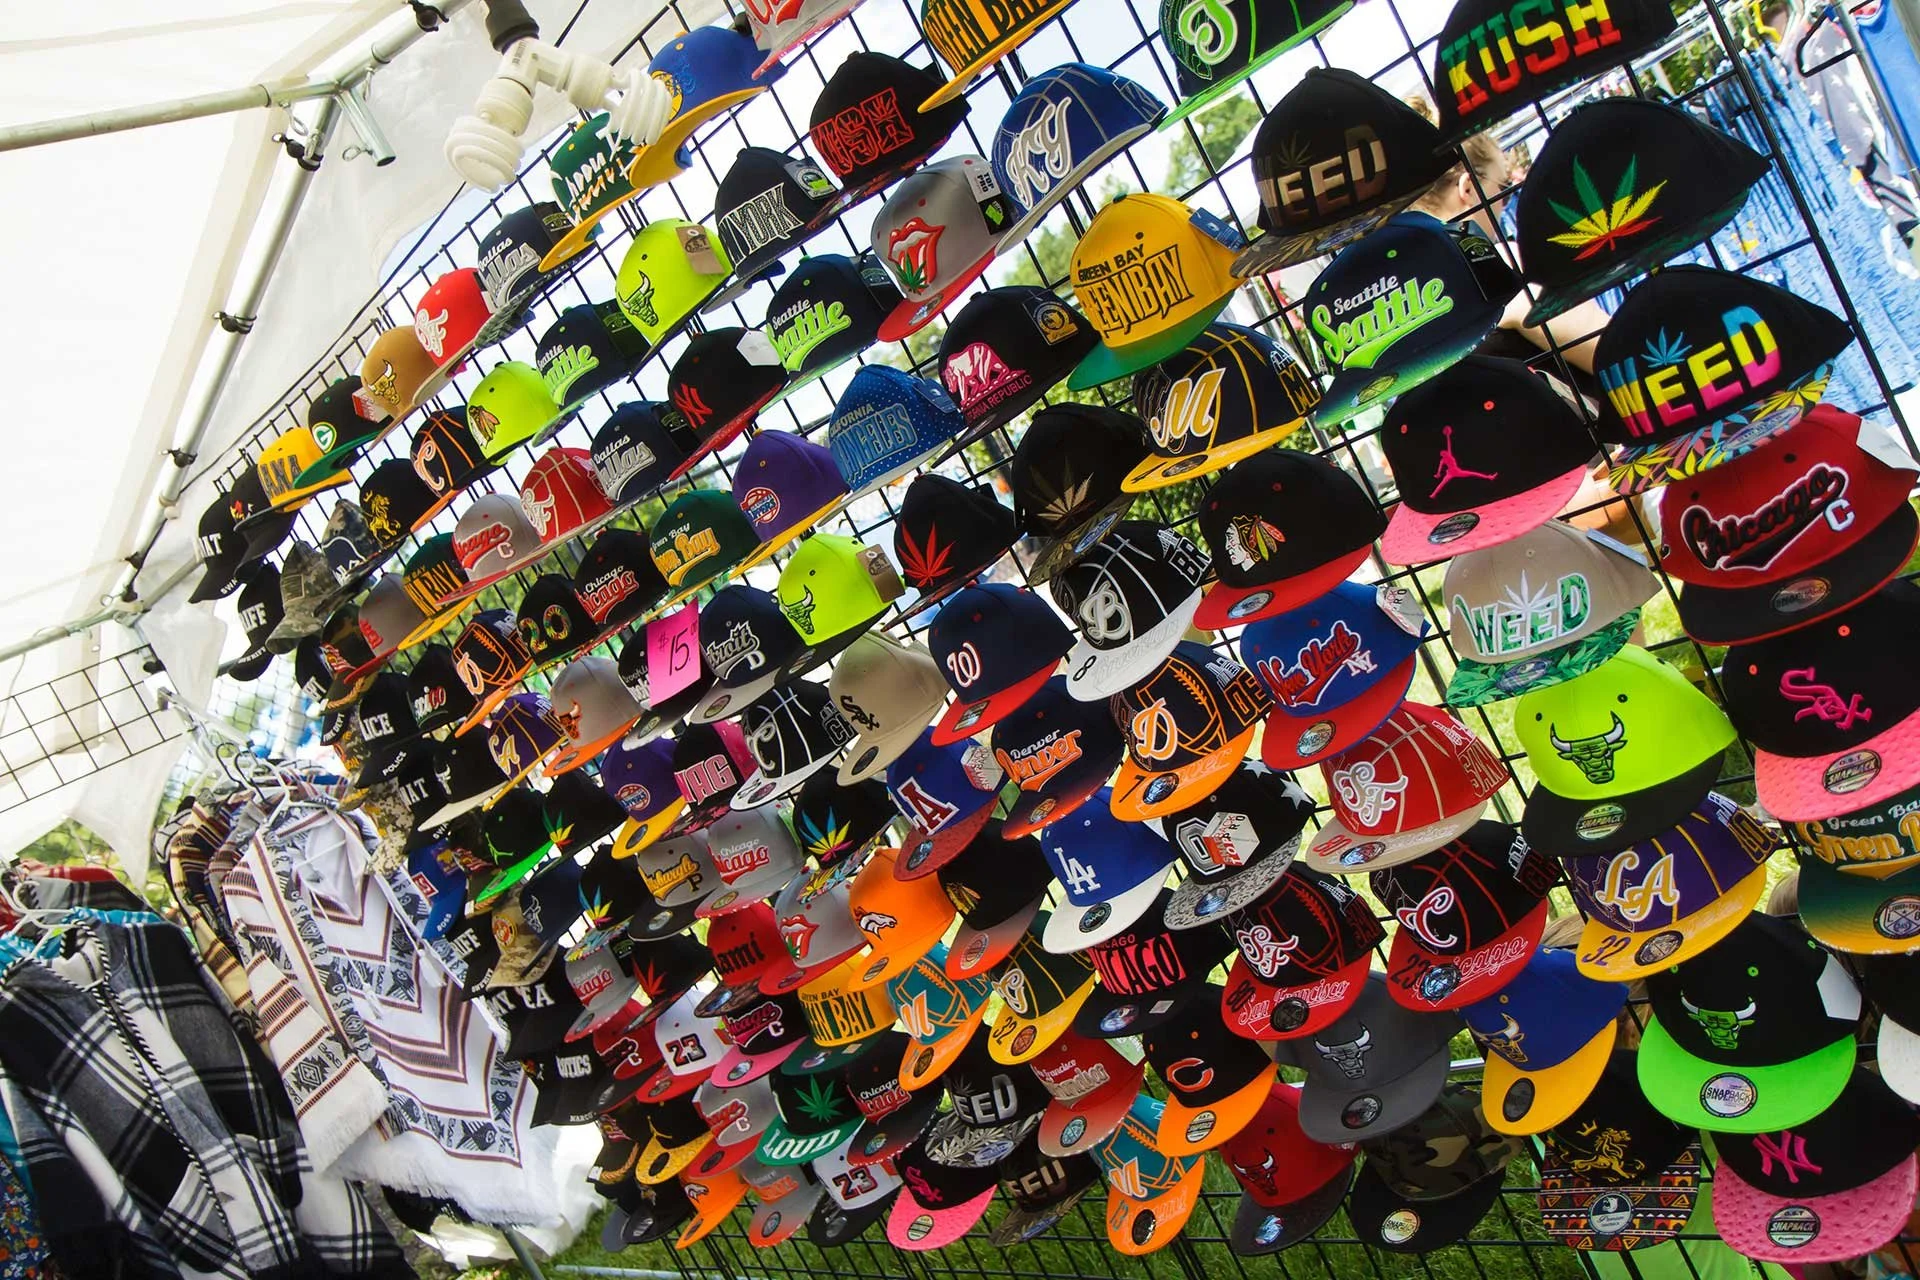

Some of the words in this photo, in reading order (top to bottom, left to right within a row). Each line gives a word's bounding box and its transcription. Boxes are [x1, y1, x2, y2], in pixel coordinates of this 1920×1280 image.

[1441, 0, 1622, 116] KUSH
[1113, 243, 1145, 269] BAY
[1334, 275, 1399, 315] Seattle
[771, 298, 811, 330] Seattle
[1311, 277, 1454, 364] Seattle
[1600, 305, 1783, 438] WEED
[987, 374, 1033, 408] REPUBLIC
[594, 434, 631, 465] Dallas
[668, 522, 691, 539] Bay
[1680, 461, 1850, 571] Chicago
[1823, 499, 1855, 532] C
[585, 565, 625, 594] Chicago
[1453, 573, 1592, 656] WEED
[746, 650, 766, 671] D
[946, 642, 982, 689] W
[1072, 655, 1097, 682] 8
[1257, 655, 1307, 705] New
[1299, 620, 1362, 682] York
[1779, 666, 1872, 730] Sox
[1010, 729, 1061, 760] Denver
[1131, 697, 1178, 761] D
[382, 751, 407, 776] POLICE
[995, 729, 1083, 784] Denver
[1827, 758, 1878, 785] SNAPBACK
[1827, 814, 1884, 831] Green
[1888, 799, 1920, 819] Ba
[721, 839, 760, 857] Chicago
[1796, 820, 1904, 864] Green
[1054, 847, 1101, 895] LA
[1594, 850, 1680, 922] LA
[1581, 935, 1632, 967] 32
[768, 1020, 784, 1037] C
[665, 1033, 706, 1067] 23
[860, 1078, 898, 1099] Chicago
[1166, 1057, 1214, 1093] C
[1705, 1086, 1752, 1104] SNAPBACK
[735, 1116, 750, 1132] C
[762, 1128, 841, 1160] LOUD
[1753, 1130, 1823, 1184] NY
[832, 1165, 878, 1201] 23
[1769, 1221, 1817, 1234] SNAPBACK
